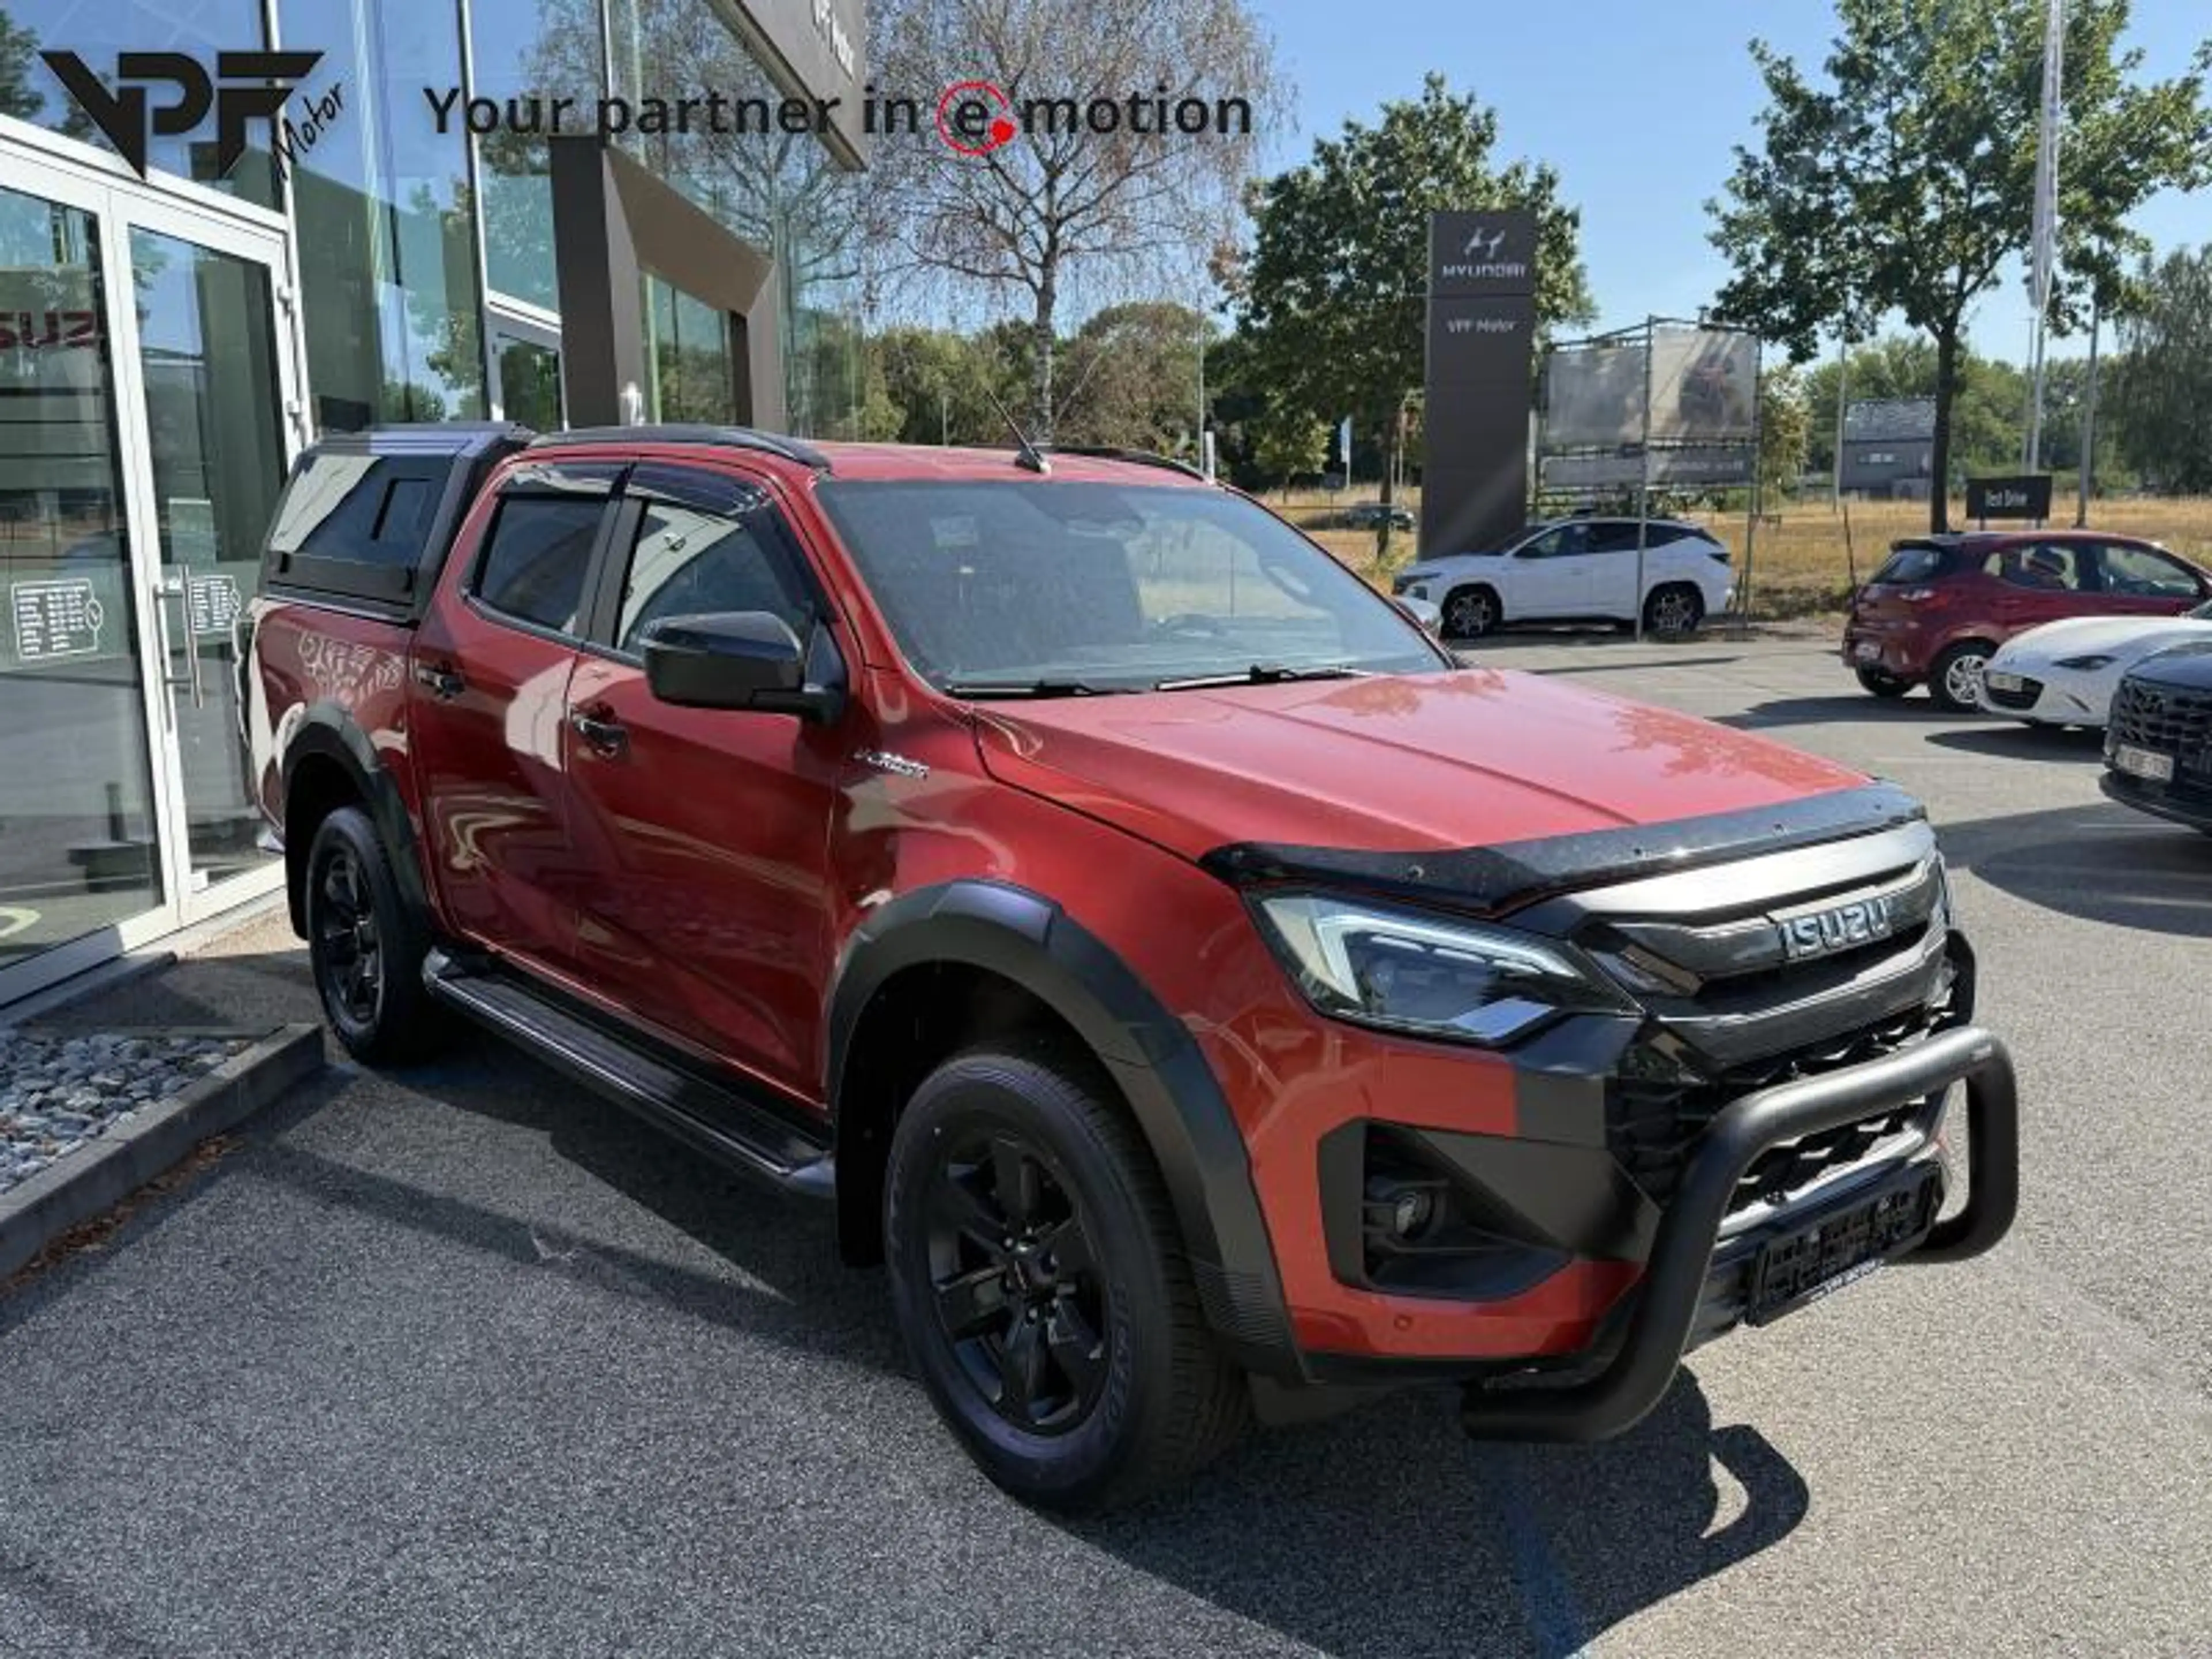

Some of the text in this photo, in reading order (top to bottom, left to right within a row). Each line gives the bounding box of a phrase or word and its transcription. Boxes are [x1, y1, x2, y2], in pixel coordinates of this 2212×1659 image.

[1442, 264, 1527, 278] HYUNDAI
[1446, 317, 1516, 334] VPF Motor
[1780, 897, 1892, 960] ISUZU
